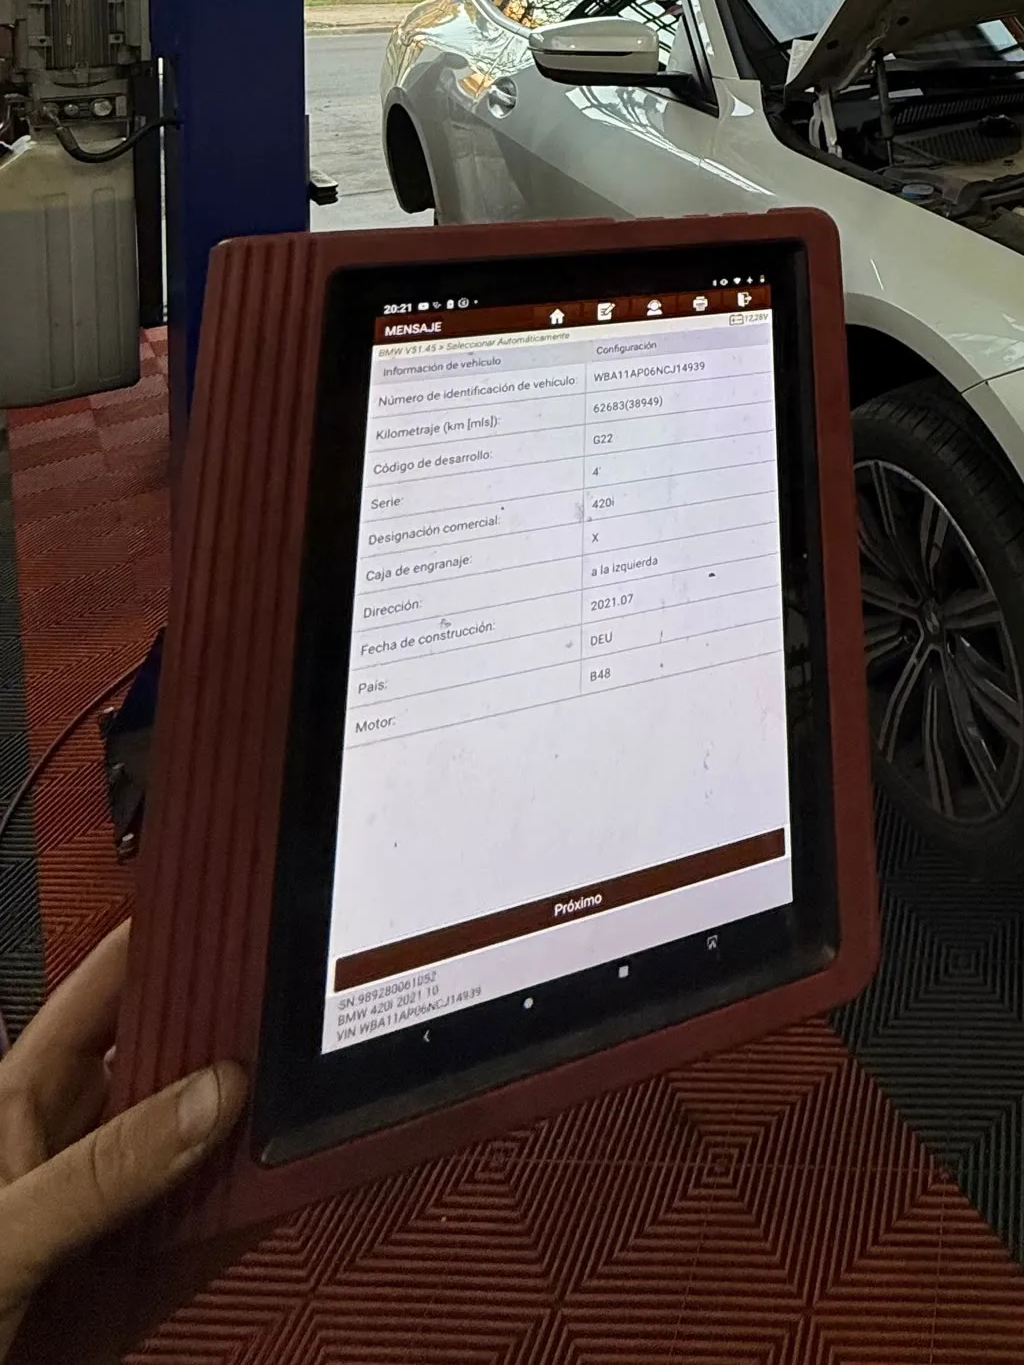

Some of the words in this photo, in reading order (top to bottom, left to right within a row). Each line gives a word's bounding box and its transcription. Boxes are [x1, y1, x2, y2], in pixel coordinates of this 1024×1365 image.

[384, 303, 412, 314] 20:21
[384, 321, 443, 336] MENSAJE
[378, 347, 404, 357] BMW
[447, 339, 495, 351] Seleccionar
[596, 341, 657, 355] Configuración
[383, 362, 444, 377] Información
[446, 360, 459, 371] de
[594, 361, 706, 382] WBA11AP06NCJ14939
[378, 394, 424, 407] Número
[426, 390, 441, 401] de
[443, 383, 515, 400] identificación
[517, 378, 531, 391] de
[593, 396, 663, 413] 62683(38949)
[375, 423, 441, 440] Kilometraje
[443, 421, 465, 434] (km
[593, 433, 613, 445] G22
[373, 461, 415, 475] Código
[417, 457, 432, 469] de
[434, 449, 494, 466] desarrollo:
[370, 497, 404, 510] Serie:
[592, 495, 615, 509] 420i
[368, 525, 440, 546] Designación
[442, 515, 501, 534] comercial:
[591, 532, 599, 543] X
[366, 567, 392, 582] Caja
[395, 564, 410, 577] de
[413, 555, 473, 574] engranaje:
[591, 568, 598, 577] a
[600, 565, 610, 575] la
[612, 556, 659, 573] izquierda
[363, 599, 423, 619] Dirección:
[591, 593, 634, 611] 2021.07
[360, 640, 397, 656] Fecha
[400, 637, 415, 649] de
[418, 621, 496, 646] construcción:
[590, 631, 613, 646] DEU
[590, 668, 611, 682] B48
[355, 716, 397, 734] Motor:
[554, 894, 603, 916] Próximo
[338, 995, 355, 1010] SN
[337, 1006, 368, 1026] BMW
[370, 999, 393, 1015] 420i
[337, 1027, 357, 1042] VIN
